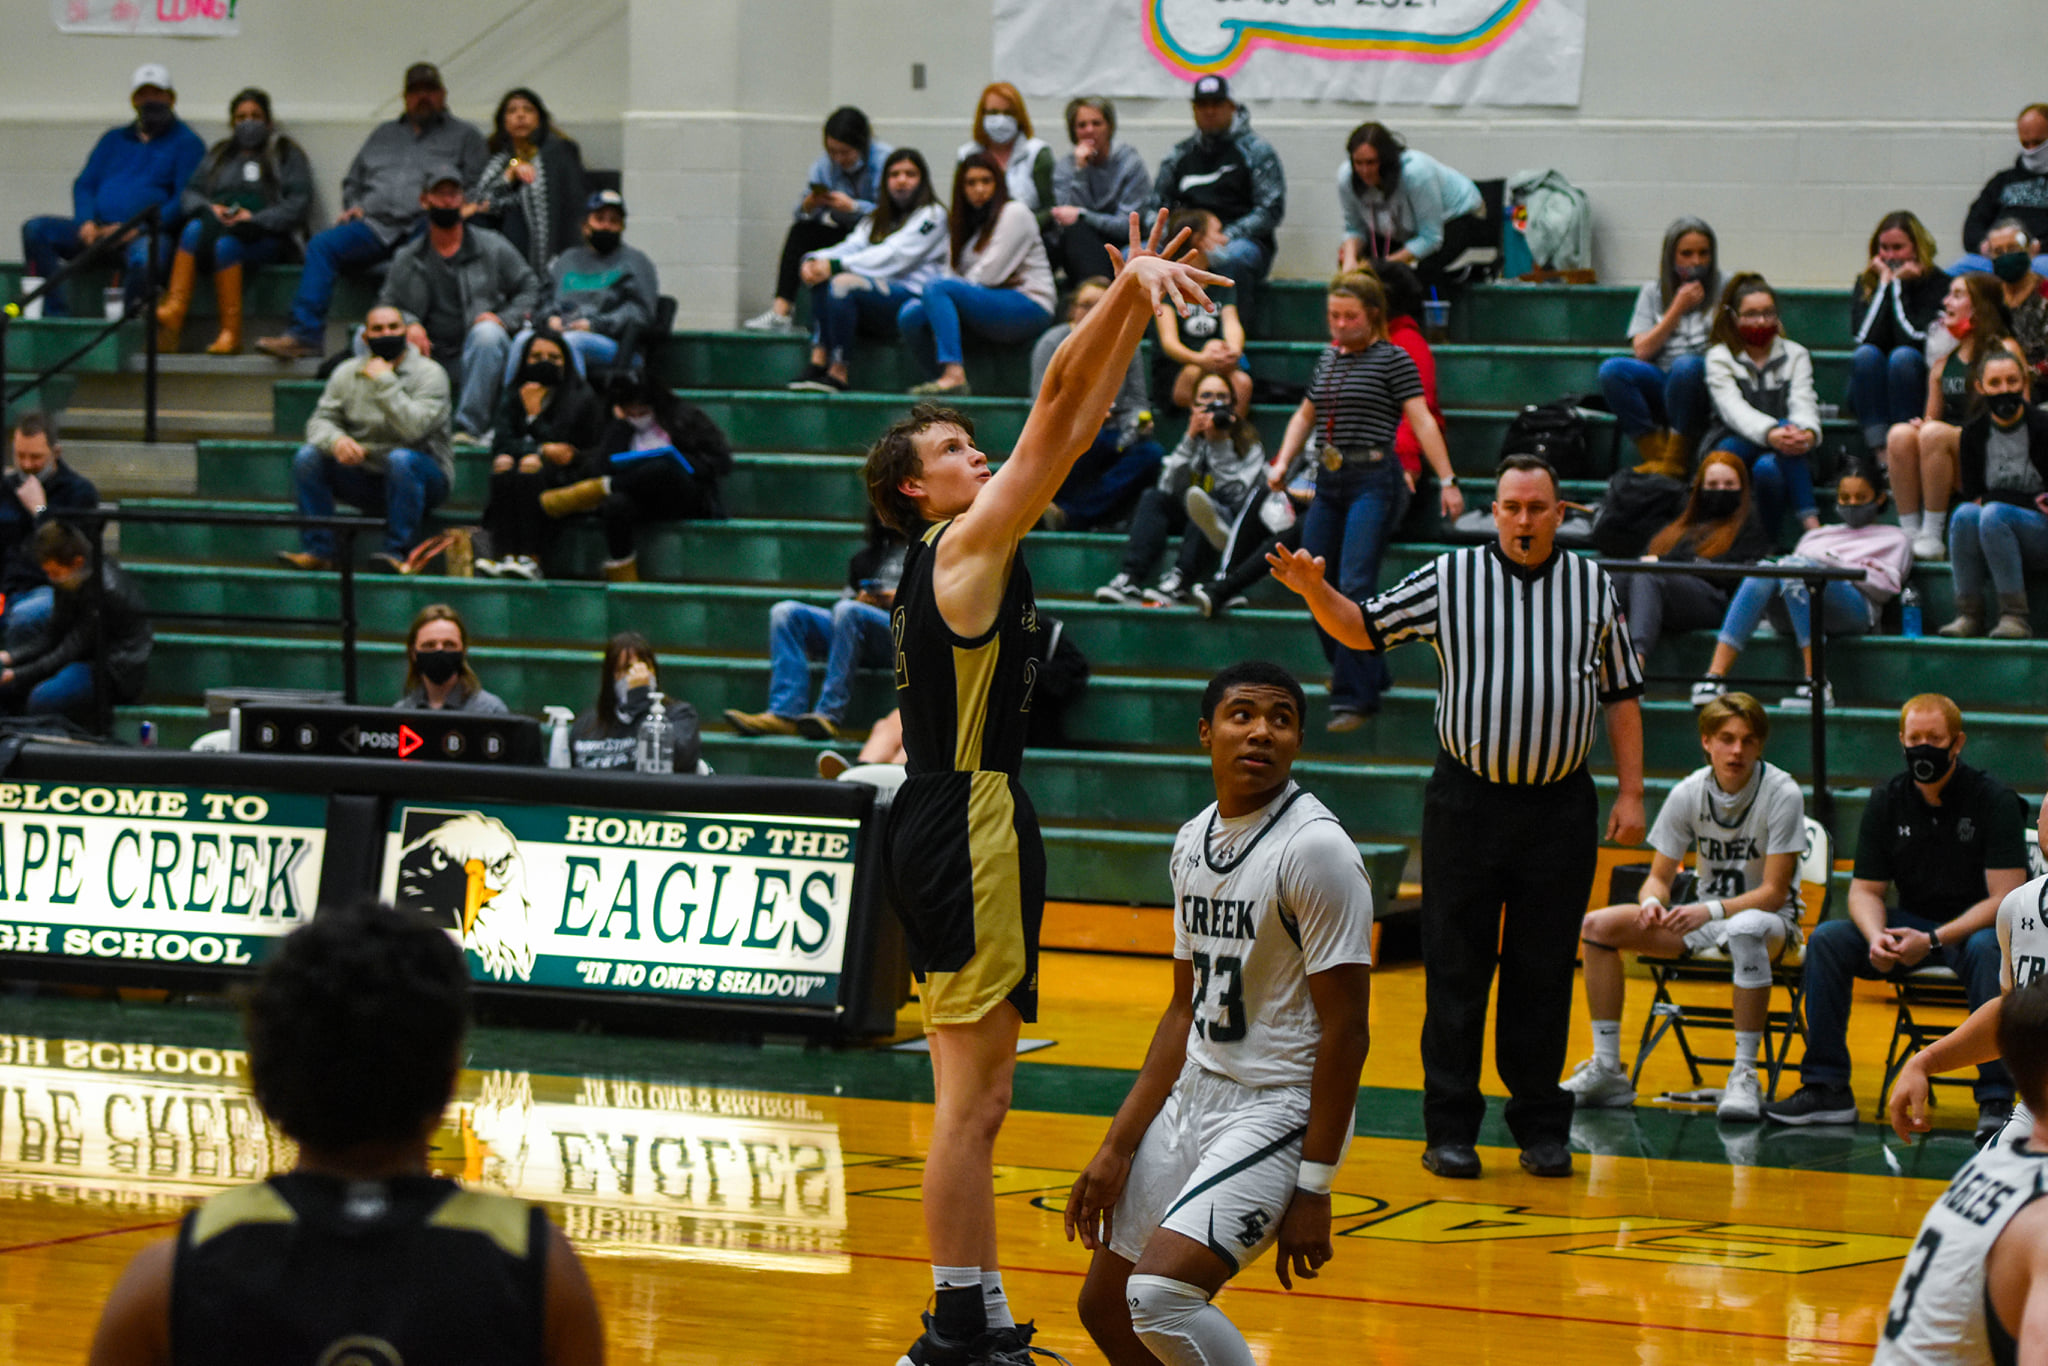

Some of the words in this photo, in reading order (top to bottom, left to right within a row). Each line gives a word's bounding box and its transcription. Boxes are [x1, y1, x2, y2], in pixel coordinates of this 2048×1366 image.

[261, 726, 274, 744] B
[300, 728, 313, 745] B
[359, 731, 399, 749] POSS
[447, 735, 460, 751] B
[487, 737, 500, 753] B
[201, 792, 270, 822] TO
[564, 815, 688, 849] HOME
[698, 824, 755, 852] OF
[765, 828, 850, 859] THE
[1697, 836, 1761, 862] CREEK
[107, 827, 306, 918] CREEK
[553, 854, 837, 954] EAGLES
[1181, 895, 1257, 940] CREEK
[62, 928, 252, 966] SCHOOL
[612, 962, 647, 988] NO
[649, 965, 715, 993] ONE'S
[1192, 951, 1247, 1042] 23
